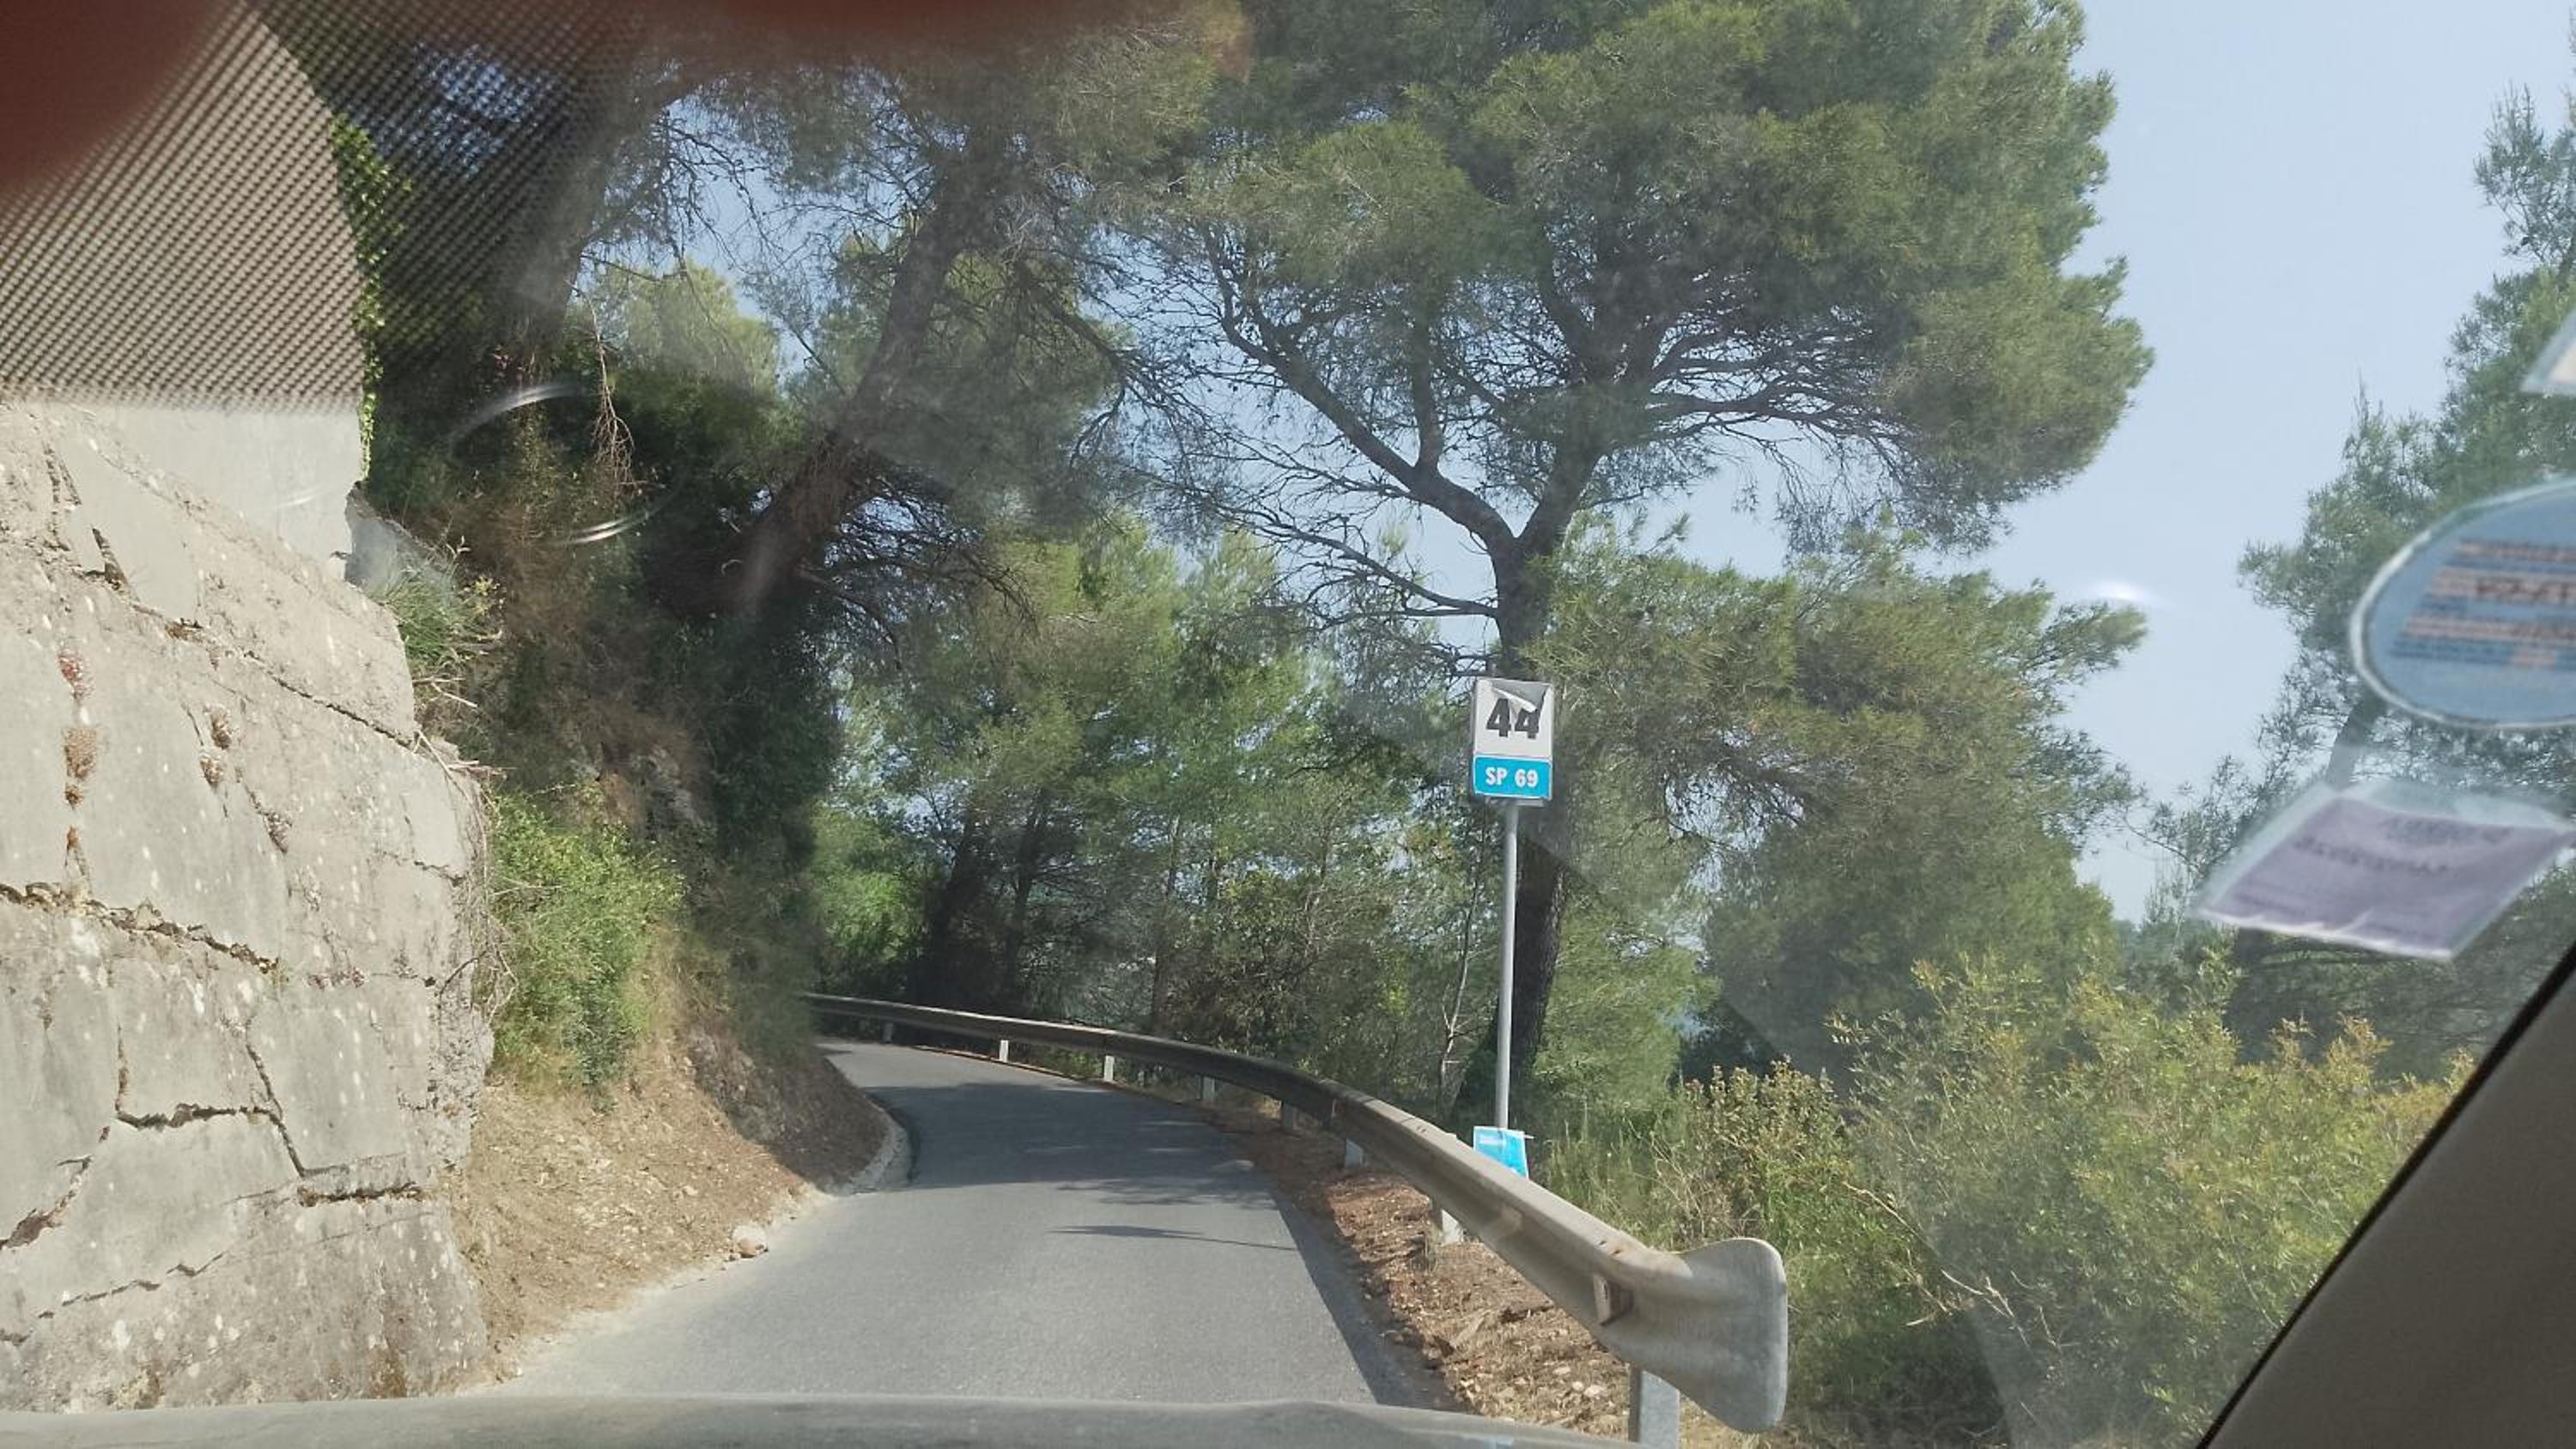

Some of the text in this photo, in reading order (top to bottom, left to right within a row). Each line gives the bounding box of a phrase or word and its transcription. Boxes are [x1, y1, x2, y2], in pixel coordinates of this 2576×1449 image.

[1486, 698, 1540, 739] 44
[1485, 767, 1538, 788] SP 69
